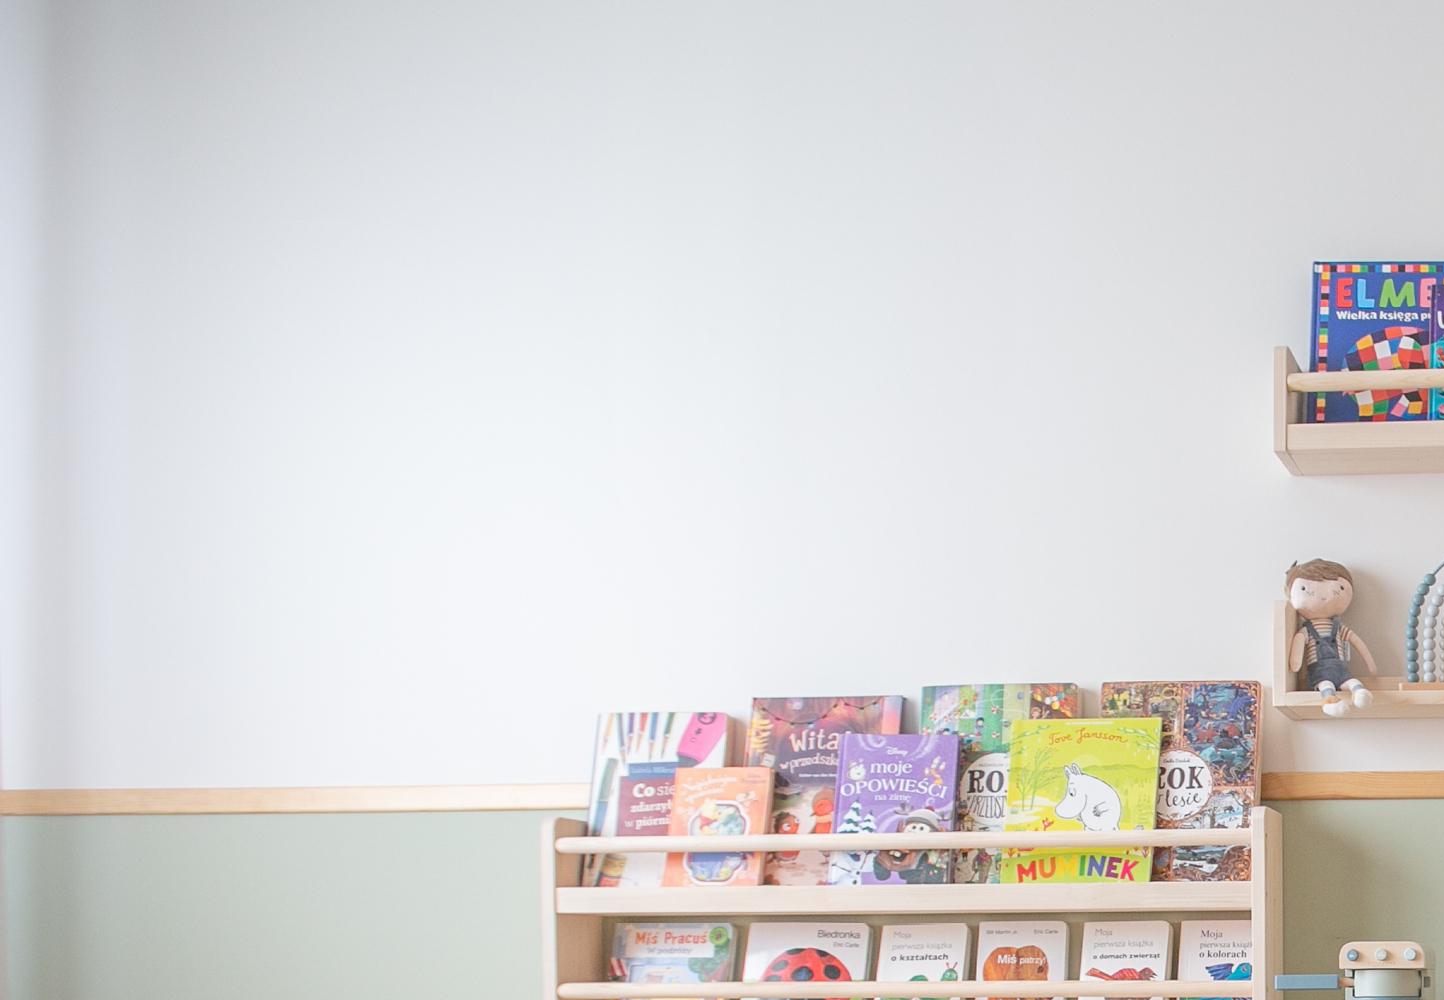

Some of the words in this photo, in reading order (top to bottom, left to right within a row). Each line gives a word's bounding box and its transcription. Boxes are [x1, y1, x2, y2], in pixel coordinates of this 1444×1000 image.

[1336, 311, 1377, 321] Wielka
[1379, 311, 1419, 322] księga
[870, 760, 912, 777] moje
[840, 777, 948, 799] OPOWIEŚCI
[967, 769, 1008, 793] RO
[632, 783, 656, 798] Co
[1017, 855, 1139, 883] MUMINEK
[635, 931, 659, 945] Miś
[664, 931, 707, 945] Pracuś
[1200, 929, 1223, 940] Moja
[899, 953, 949, 961] kształtach
[997, 953, 1017, 965] Miś
[1207, 950, 1247, 958] kolorach
